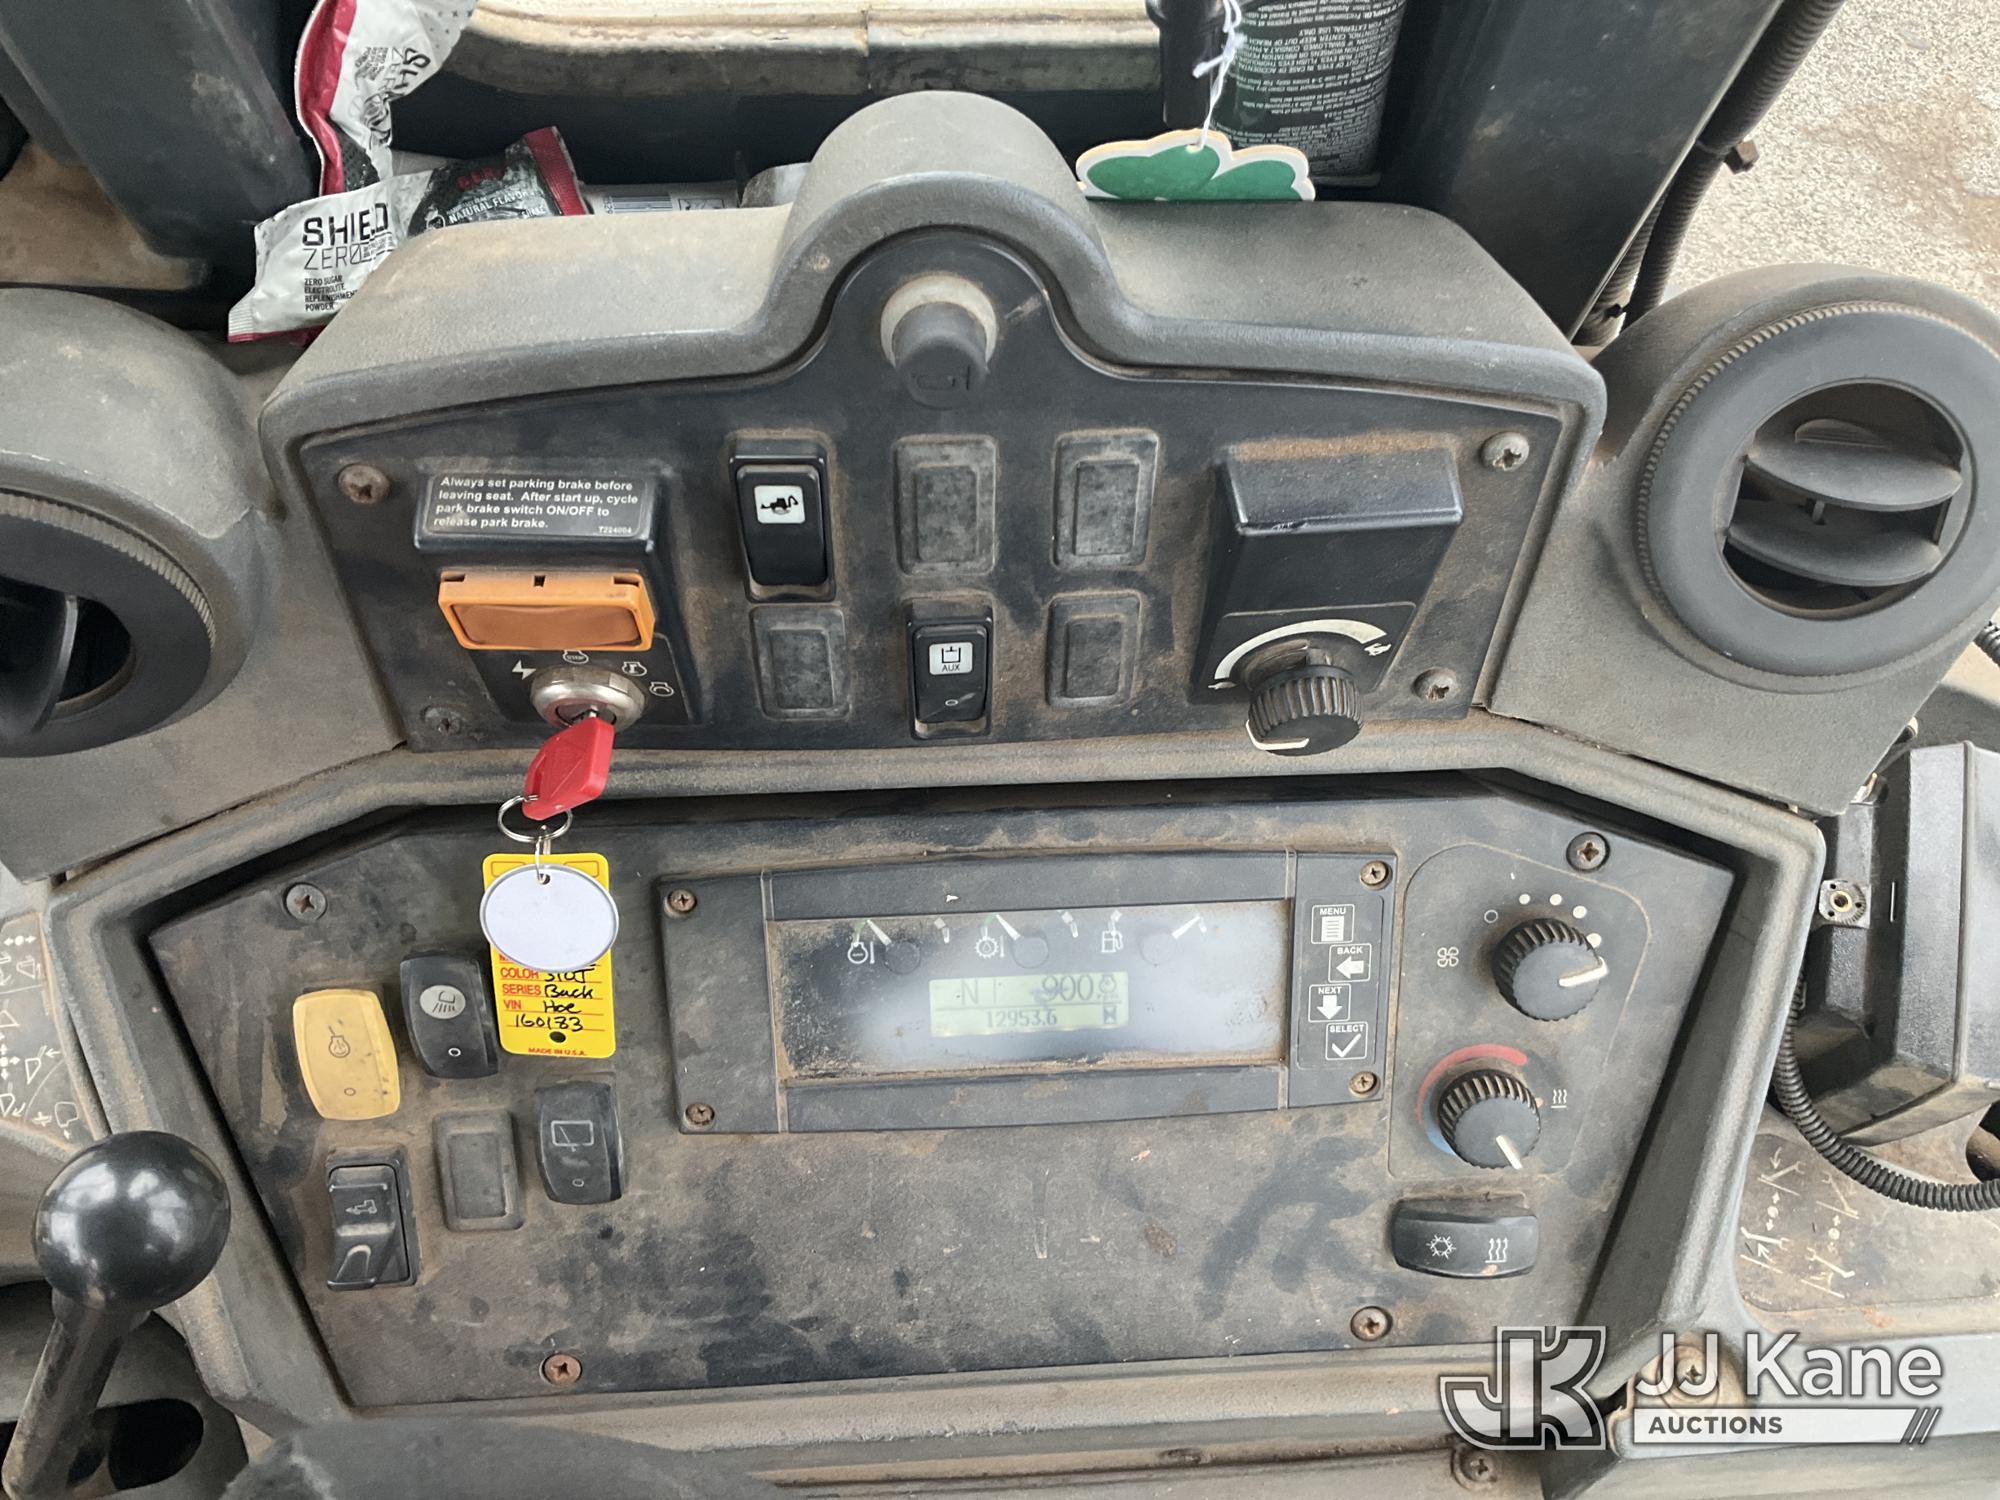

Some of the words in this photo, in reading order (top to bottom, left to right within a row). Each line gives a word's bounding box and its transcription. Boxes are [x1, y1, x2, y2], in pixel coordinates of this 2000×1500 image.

[1298, 27, 1316, 36] ONLY
[1318, 26, 1331, 34] USE
[1332, 23, 1367, 34] EXTERNAL
[1347, 27, 1379, 39] CONTROL
[1249, 38, 1272, 47] REACH
[1284, 37, 1298, 45] OUT
[1299, 36, 1317, 45] KEEP
[1345, 59, 1359, 68] OUT
[448, 200, 493, 220] NATURAL
[302, 203, 389, 246] SHIED
[304, 278, 323, 286] ZERO
[324, 275, 343, 285] SUGAR
[305, 301, 335, 312] POWDER
[440, 477, 484, 489] Always
[487, 478, 506, 488] set
[509, 478, 554, 491] parking
[558, 479, 591, 490] brake
[595, 480, 633, 491] before
[439, 490, 482, 502] leaving
[486, 491, 514, 501] seat.
[521, 492, 551, 502] After
[554, 492, 581, 503] start
[585, 495, 603, 505] up,
[607, 494, 638, 505] cycle
[436, 503, 463, 515] park
[466, 504, 500, 514] brake
[503, 504, 543, 515] switch
[546, 505, 594, 516] ON/OFF
[597, 506, 609, 517] to
[434, 516, 477, 527] release
[480, 518, 508, 529] park
[511, 518, 549, 529] brake.
[941, 663, 961, 673] AUX
[1319, 907, 1346, 916] MENU
[1337, 945, 1364, 955] BACK
[500, 967, 539, 979] COLOR
[502, 984, 541, 995] SERIES
[544, 984, 593, 999] Back
[960, 979, 979, 1006] N
[1041, 974, 1094, 1002] 900
[1318, 986, 1342, 995] NEXT
[503, 1000, 522, 1009] VIN
[543, 1000, 582, 1014] Hoe
[985, 1008, 1058, 1028] 12953.6
[1329, 1024, 1365, 1033] SELECT
[528, 1047, 552, 1055] MADE
[563, 1048, 588, 1056] U.S.A.
